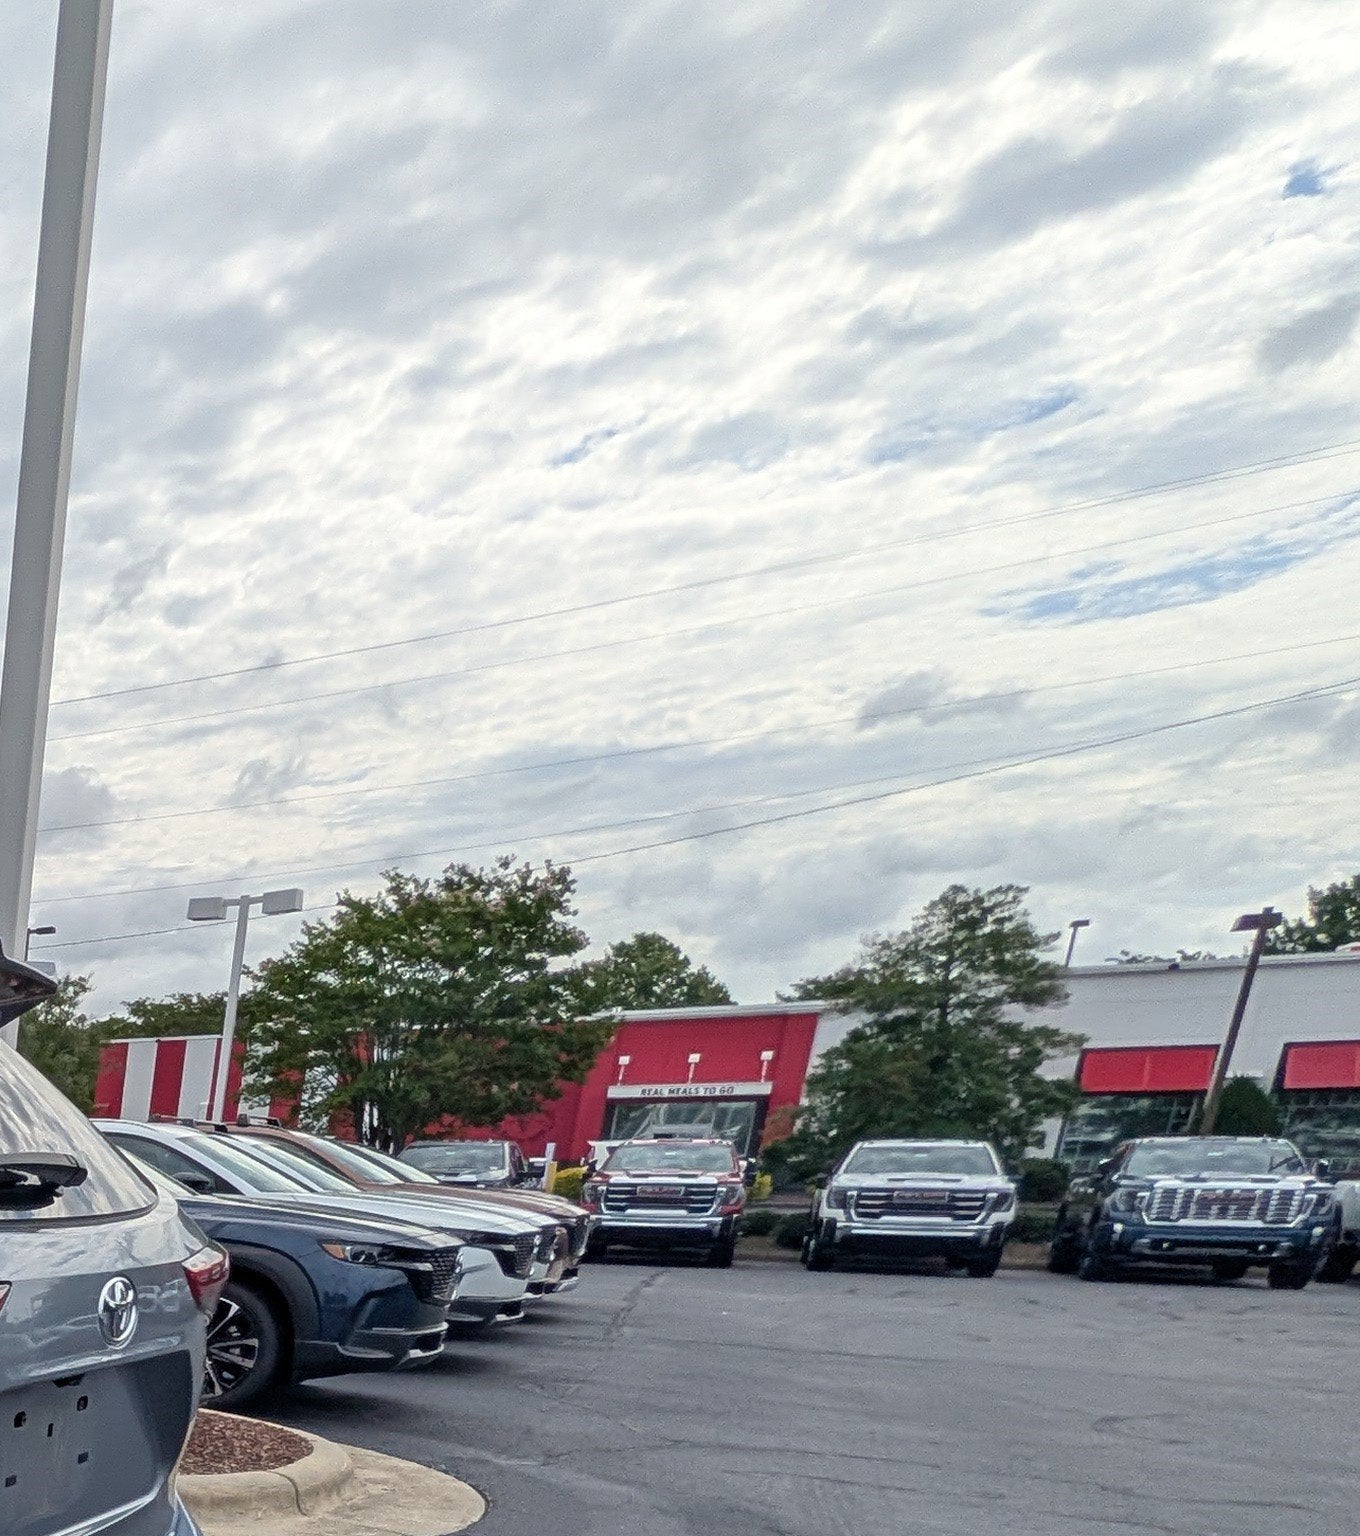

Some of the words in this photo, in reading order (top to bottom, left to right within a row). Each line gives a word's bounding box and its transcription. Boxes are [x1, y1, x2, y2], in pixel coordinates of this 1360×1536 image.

[640, 1088, 664, 1096] REAL
[668, 1087, 700, 1095] MEALS
[703, 1087, 716, 1095] TO
[719, 1086, 734, 1094] GO
